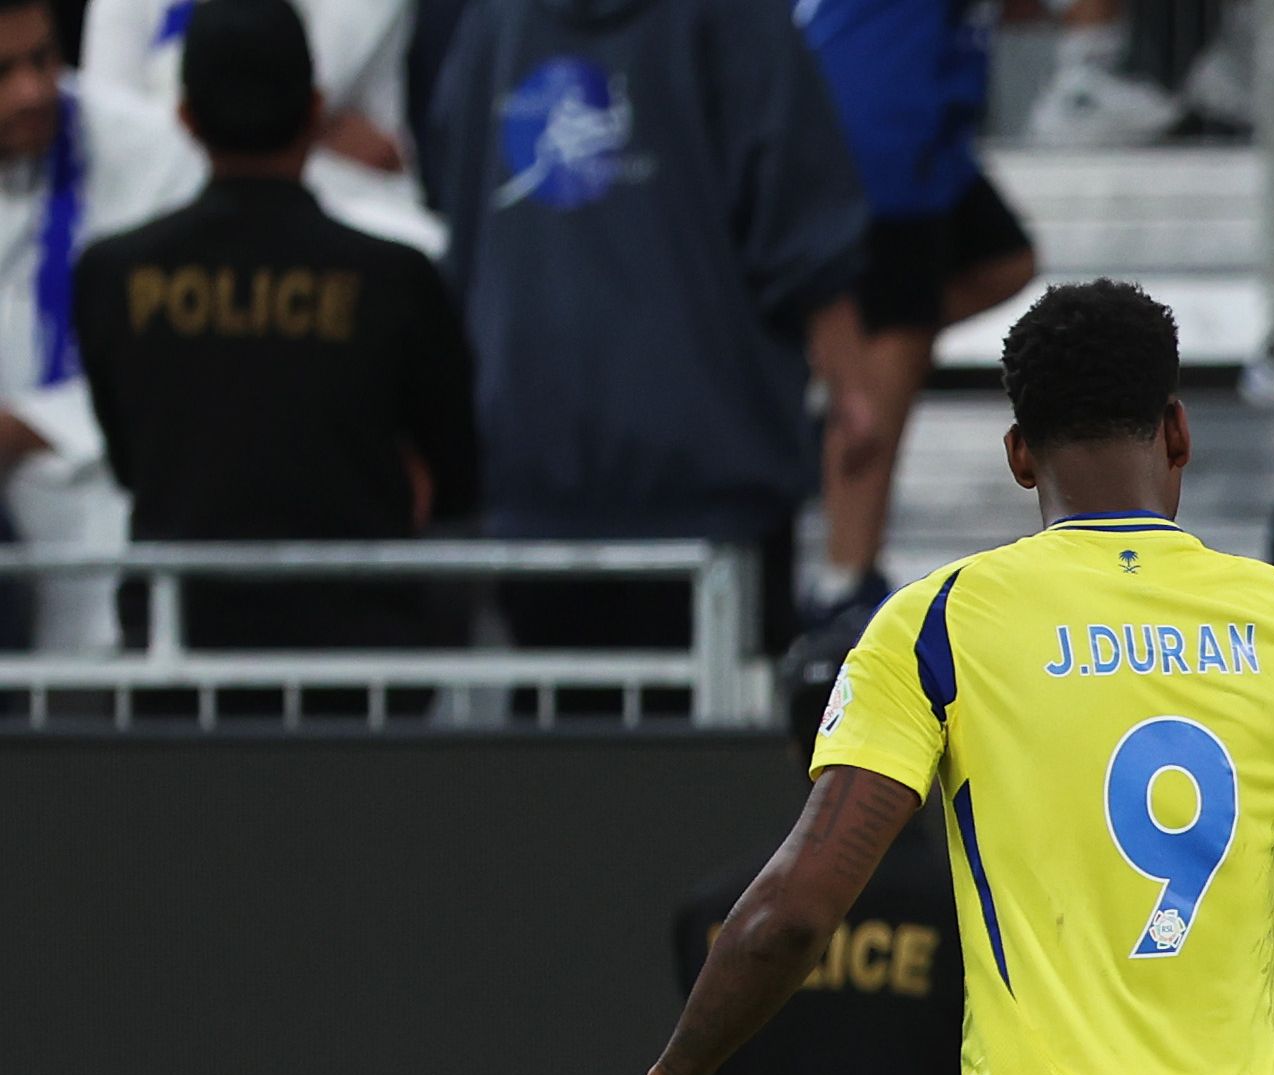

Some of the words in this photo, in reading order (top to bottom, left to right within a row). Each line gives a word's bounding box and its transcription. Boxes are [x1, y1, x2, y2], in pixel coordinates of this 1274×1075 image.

[129, 266, 361, 341] POLICE
[1044, 622, 1260, 677] J.DURAN
[1103, 715, 1239, 959] 9
